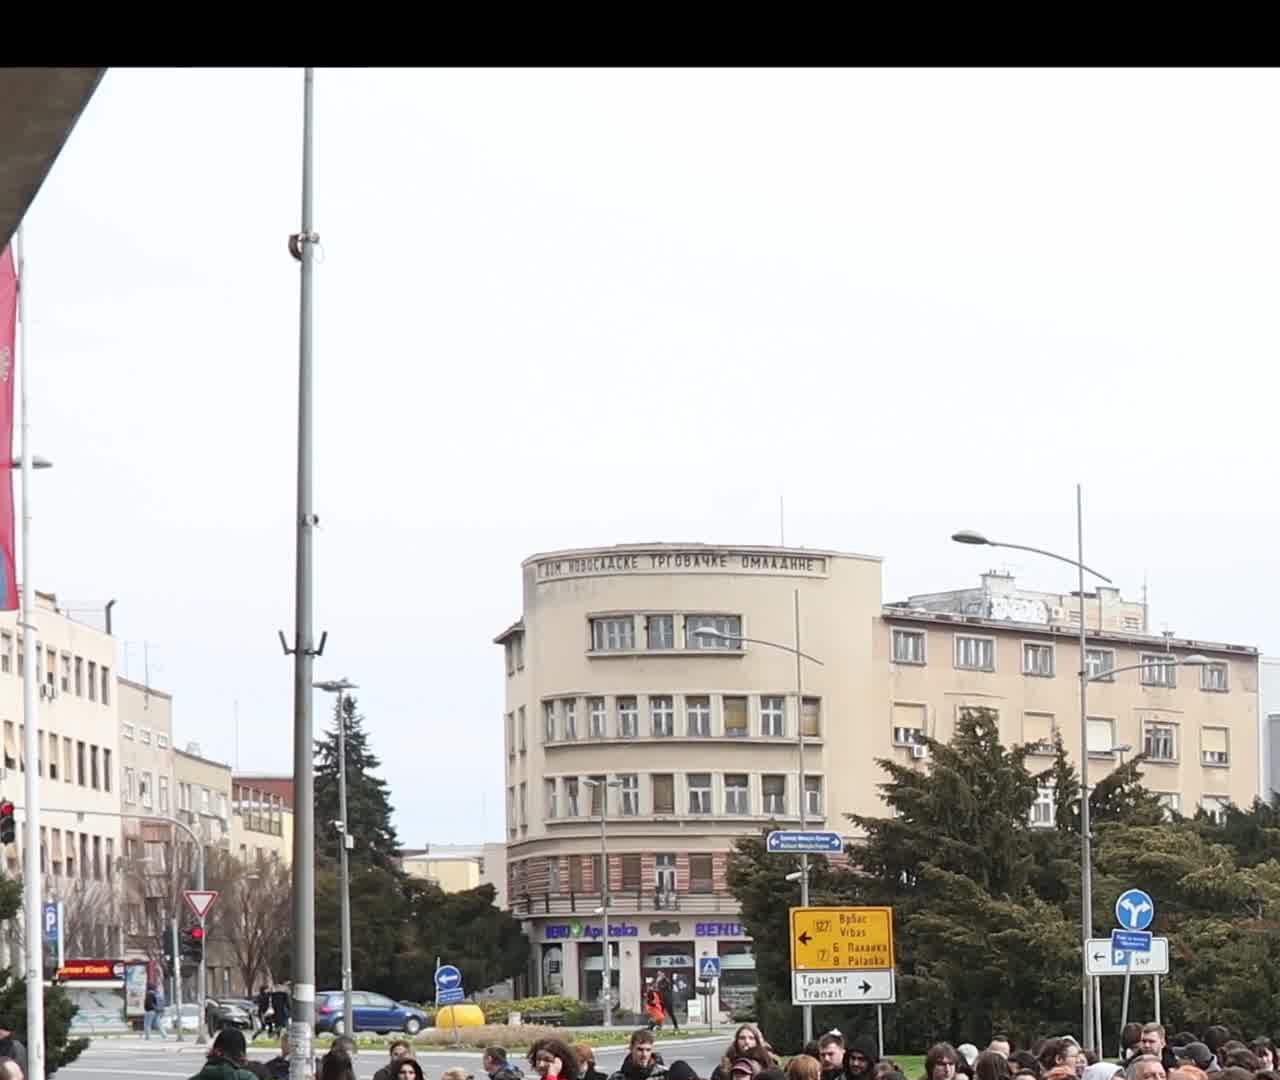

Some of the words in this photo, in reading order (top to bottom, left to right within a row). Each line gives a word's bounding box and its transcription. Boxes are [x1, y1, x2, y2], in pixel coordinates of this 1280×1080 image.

[568, 555, 639, 573] НОВОСАДСКЕ
[649, 554, 728, 568] ТРГОВАЧКЕ
[839, 913, 866, 925] Врбас
[840, 927, 866, 938] Vrbas
[848, 955, 886, 967] Palanka
[802, 975, 849, 986] Транзит
[802, 988, 843, 999] Tranzit
